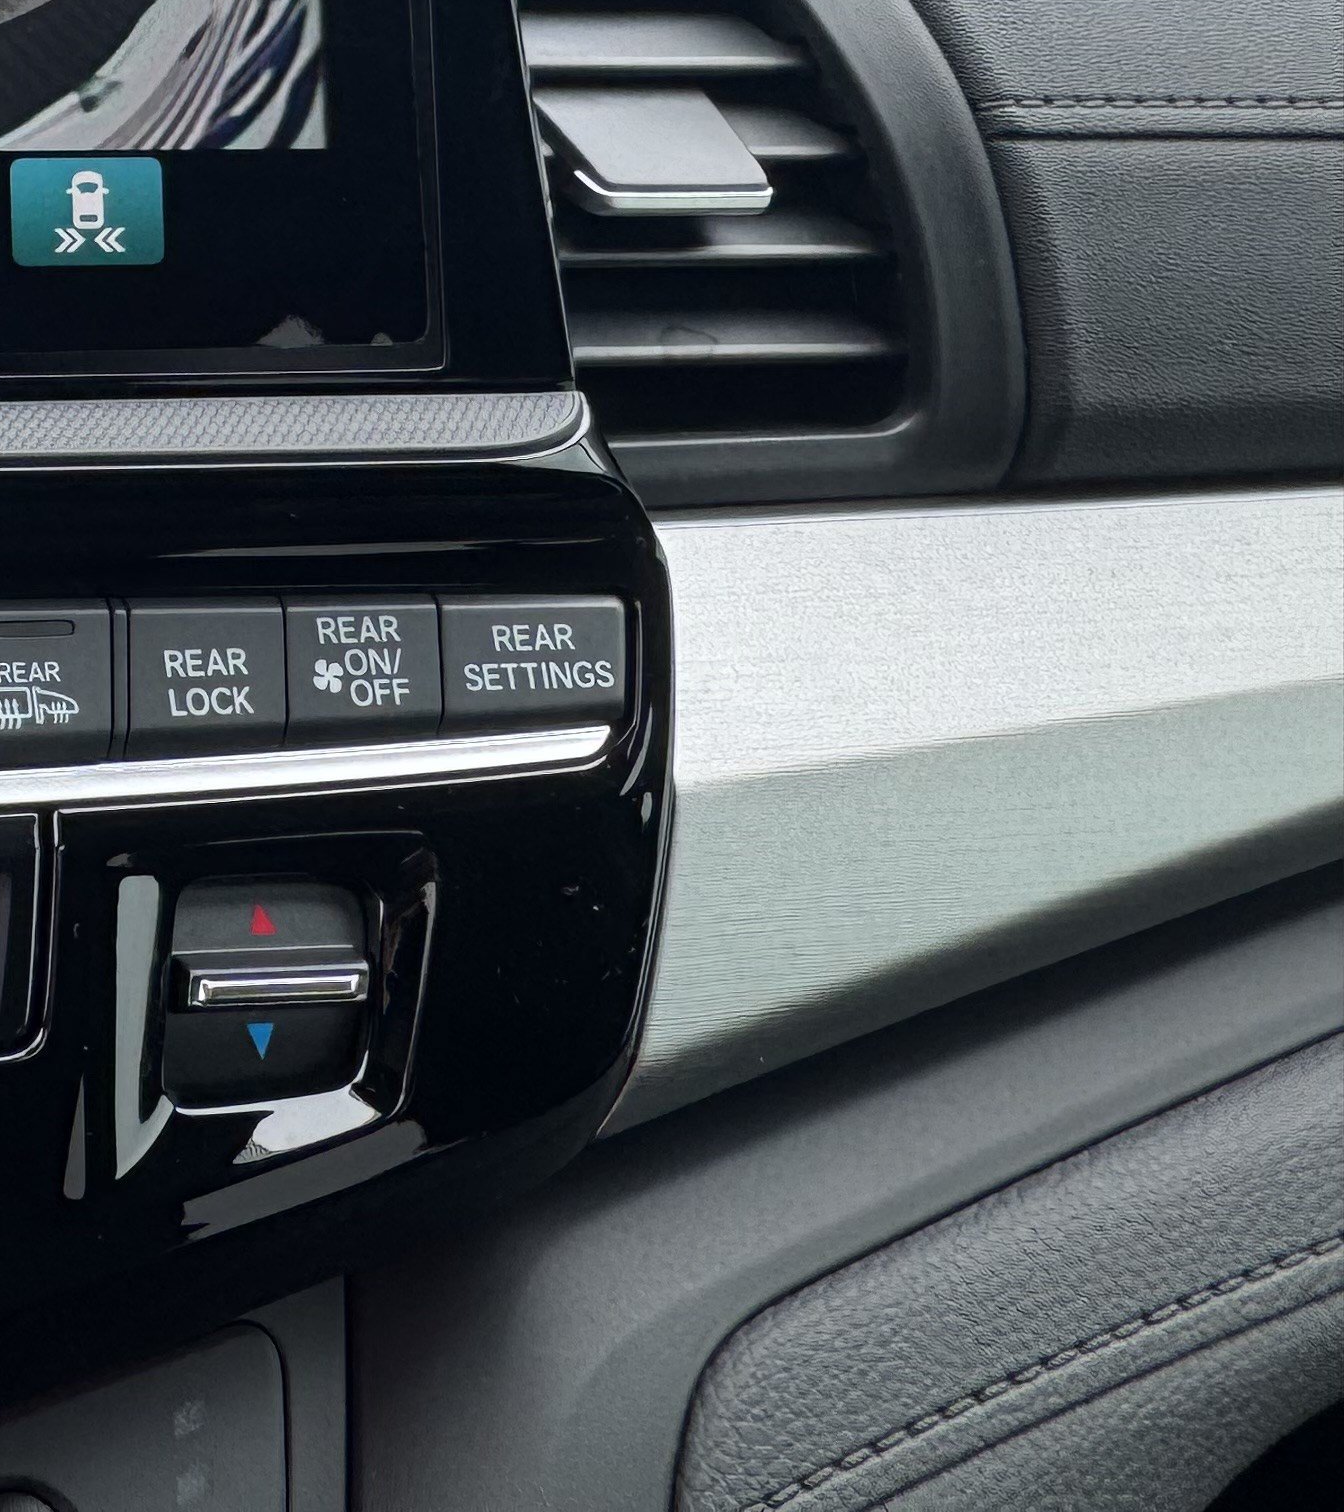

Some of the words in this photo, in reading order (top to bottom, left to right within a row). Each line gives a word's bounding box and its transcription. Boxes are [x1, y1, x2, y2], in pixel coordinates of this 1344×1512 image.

[316, 614, 402, 645] REAR
[491, 623, 576, 652] REAR
[163, 647, 249, 678] REAR
[345, 647, 402, 676] ON/
[463, 660, 616, 693] SETTINGS
[168, 685, 255, 717] LOCK
[349, 678, 410, 708] OFF
